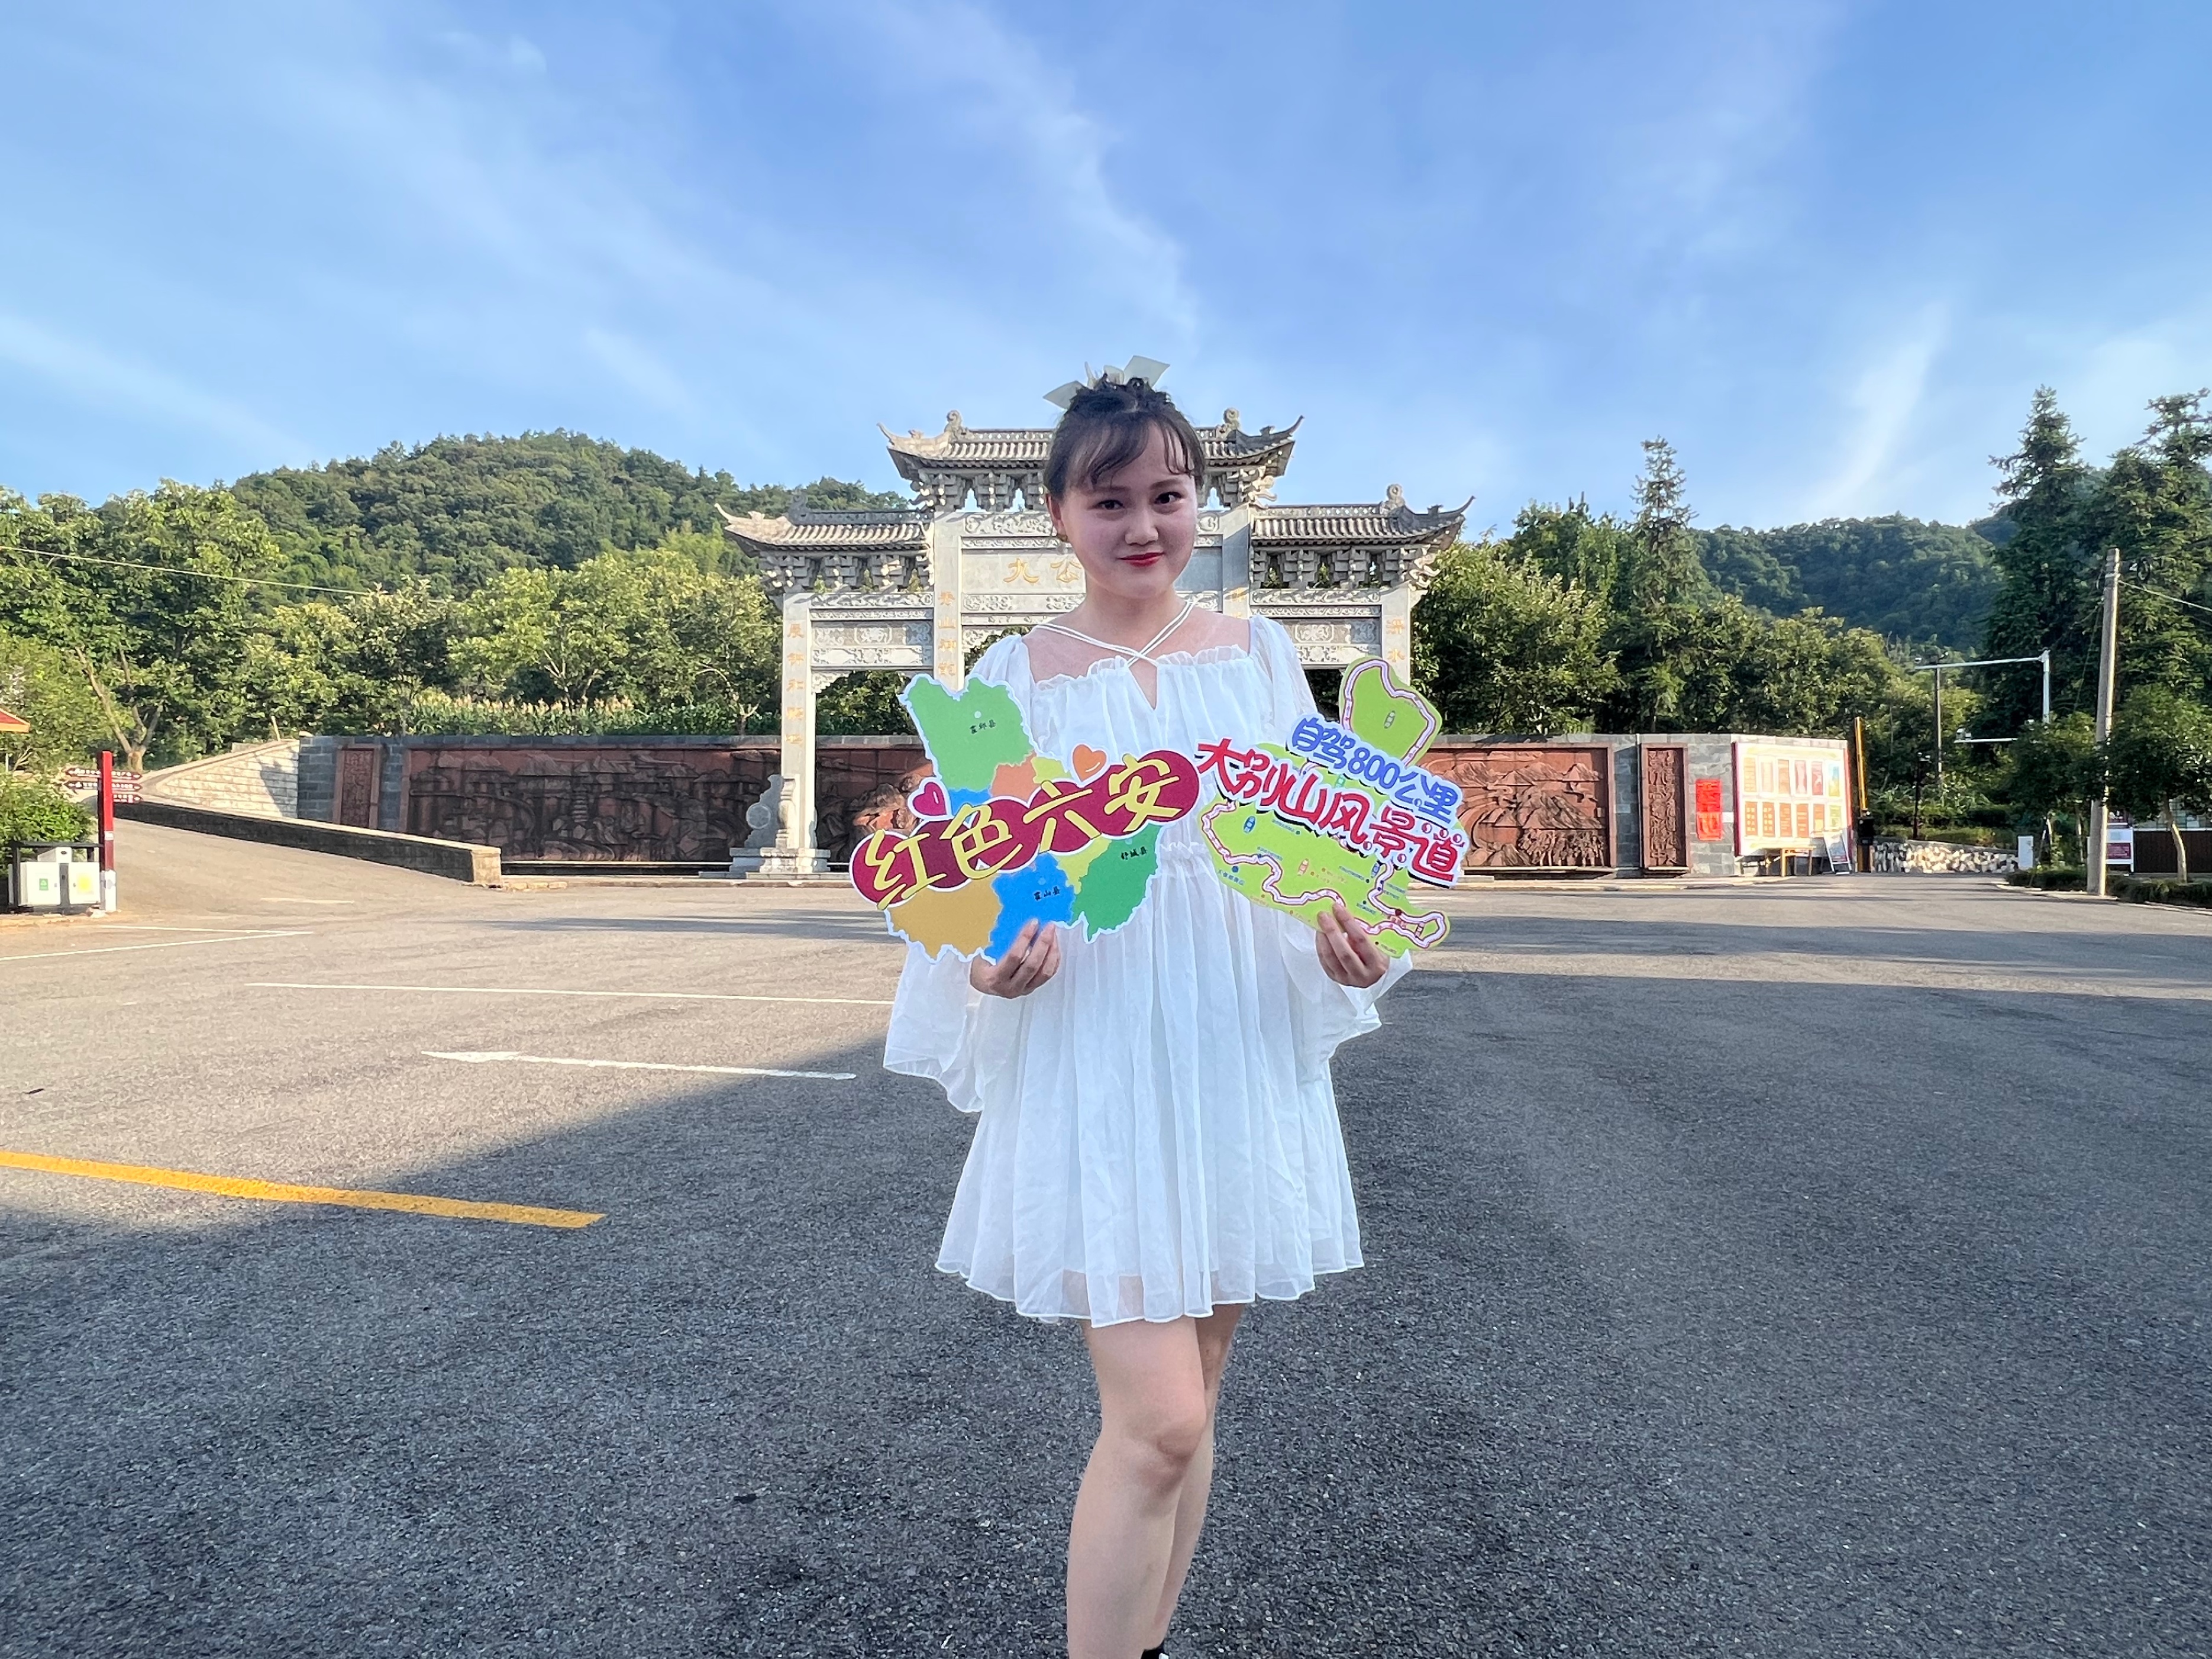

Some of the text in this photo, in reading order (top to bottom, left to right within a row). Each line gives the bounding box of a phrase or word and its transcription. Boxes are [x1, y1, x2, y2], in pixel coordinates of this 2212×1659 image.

[866, 754, 1182, 909] 红色六安
[1197, 738, 1465, 882] 大别山风景道
[1291, 717, 1459, 823] 自驾800公里
